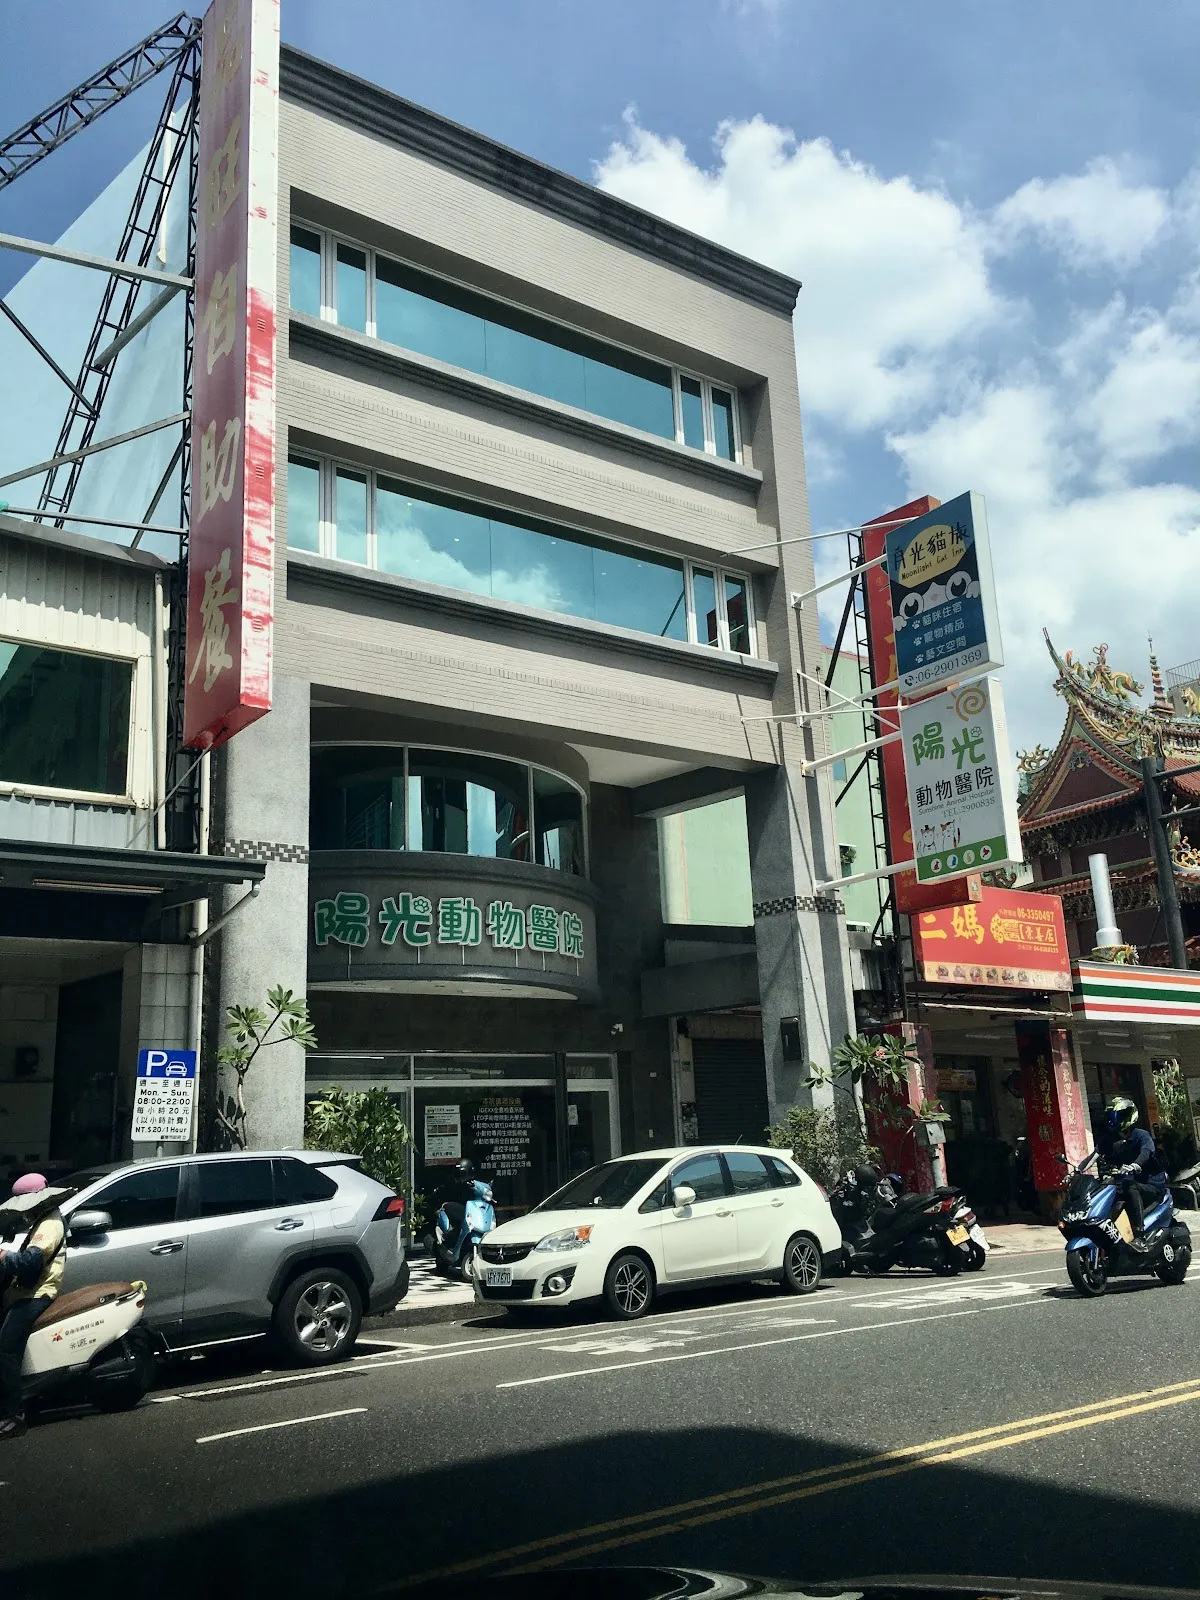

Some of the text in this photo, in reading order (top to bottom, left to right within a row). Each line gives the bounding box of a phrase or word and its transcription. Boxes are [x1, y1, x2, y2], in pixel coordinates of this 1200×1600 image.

[901, 547, 965, 581] Moonlight Cat Inn
[921, 601, 962, 627] 貓咪住宿
[923, 618, 965, 644] 寵物精品
[925, 635, 967, 660] 藝文空間
[912, 721, 986, 770] 陽光
[915, 766, 994, 808] 動物醫院
[918, 788, 995, 816] Sunshine Animal Hospital
[314, 892, 585, 958] 陽光動物醫院
[146, 1050, 168, 1076] P
[137, 1097, 191, 1105] 08:00-22:00
